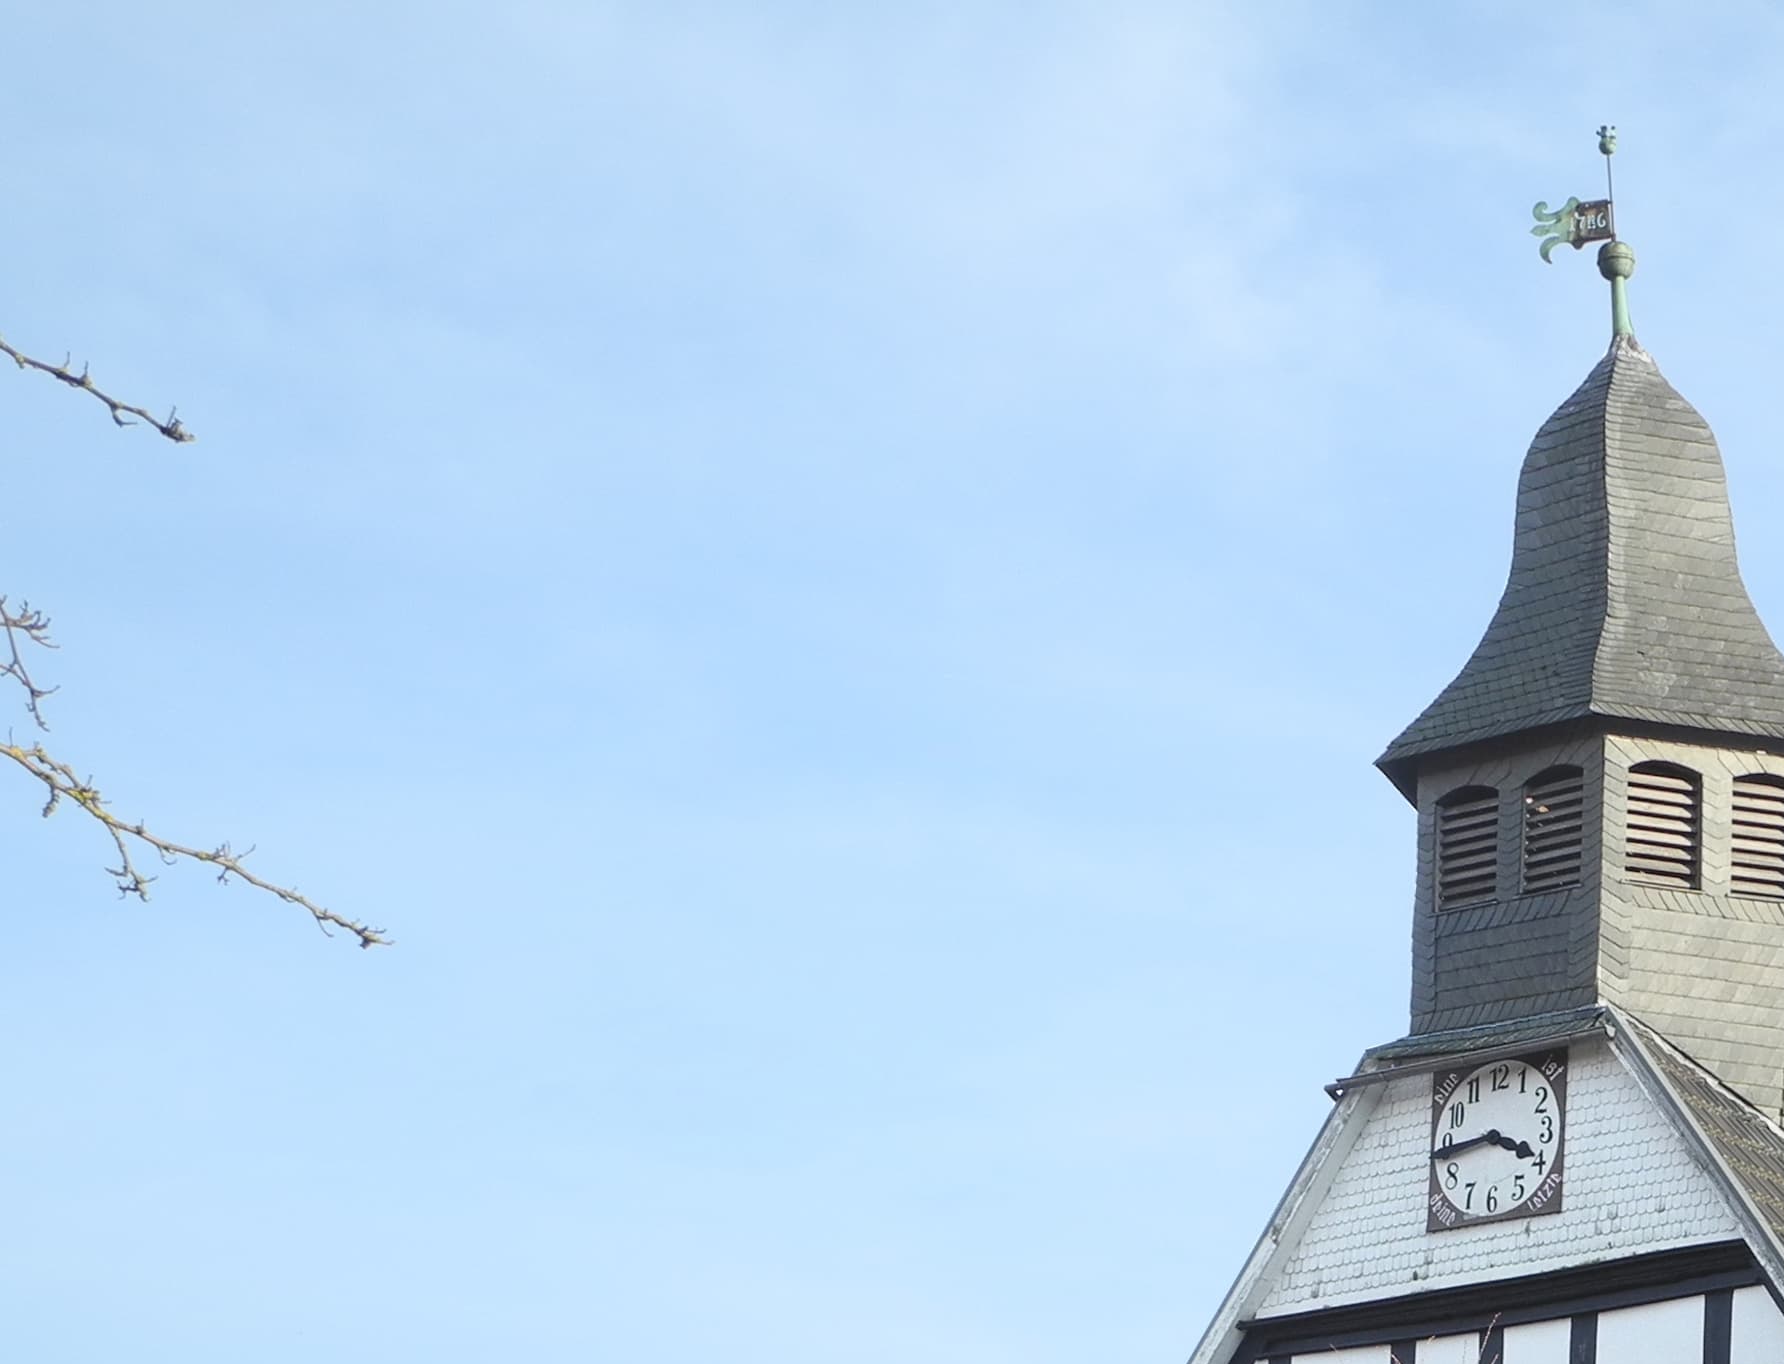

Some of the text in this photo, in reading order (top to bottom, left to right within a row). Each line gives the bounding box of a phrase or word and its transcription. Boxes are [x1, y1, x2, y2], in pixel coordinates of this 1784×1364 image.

[1467, 1076, 1480, 1104] 11
[1489, 1064, 1510, 1092] 12
[1518, 1067, 1527, 1094] 1
[1534, 1086, 1548, 1114] 2
[1449, 1101, 1465, 1129] 10
[1539, 1116, 1553, 1144] 3
[1445, 1162, 1459, 1190] 8
[1531, 1149, 1546, 1176] 4
[1464, 1181, 1476, 1210] 7
[1486, 1185, 1498, 1213] 6
[1511, 1174, 1525, 1201] 5
